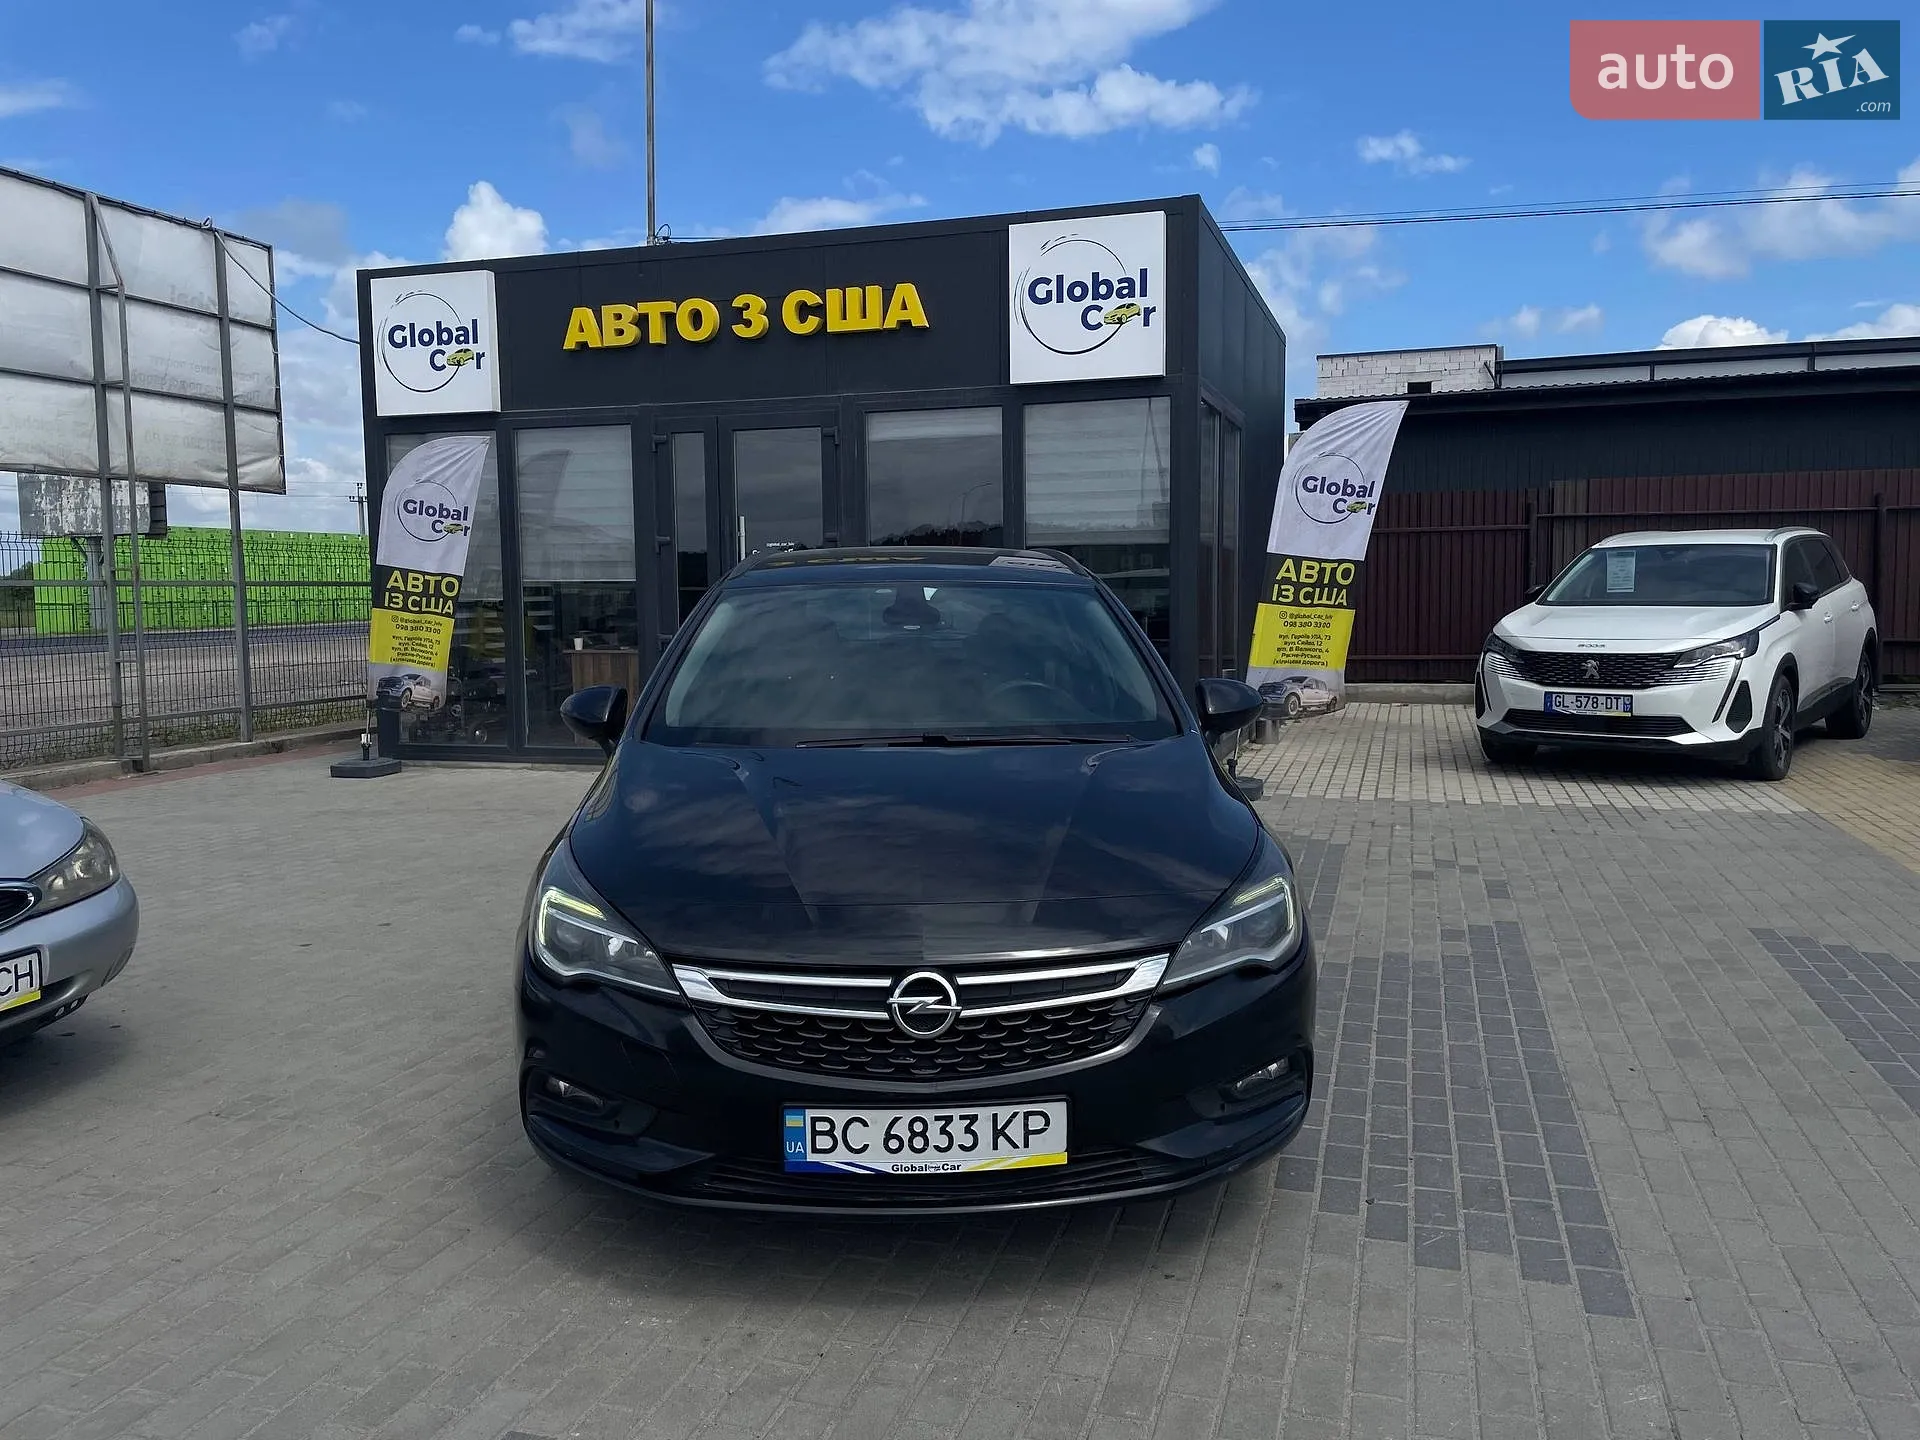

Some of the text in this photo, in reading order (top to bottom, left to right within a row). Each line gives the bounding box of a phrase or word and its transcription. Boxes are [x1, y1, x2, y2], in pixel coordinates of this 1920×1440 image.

[1028, 267, 1148, 305] Global
[562, 298, 720, 350] АВТО
[782, 283, 930, 337] США
[1081, 303, 1156, 331] Cr
[388, 319, 478, 348] Global
[429, 349, 485, 371] Cr
[1302, 476, 1376, 498] Global
[403, 499, 469, 521] Global
[1332, 498, 1376, 515] Cr
[431, 520, 470, 536] Cr
[1275, 558, 1355, 586] АВТО
[386, 570, 459, 597] АВТО
[384, 592, 453, 615] ІЗ США
[1272, 584, 1348, 606] ІЗ США
[1554, 694, 1622, 710] GL-578-DT
[810, 1110, 1050, 1155] BC 6833 KP
[786, 1142, 804, 1153] UA
[891, 1162, 962, 1173] Global Car
